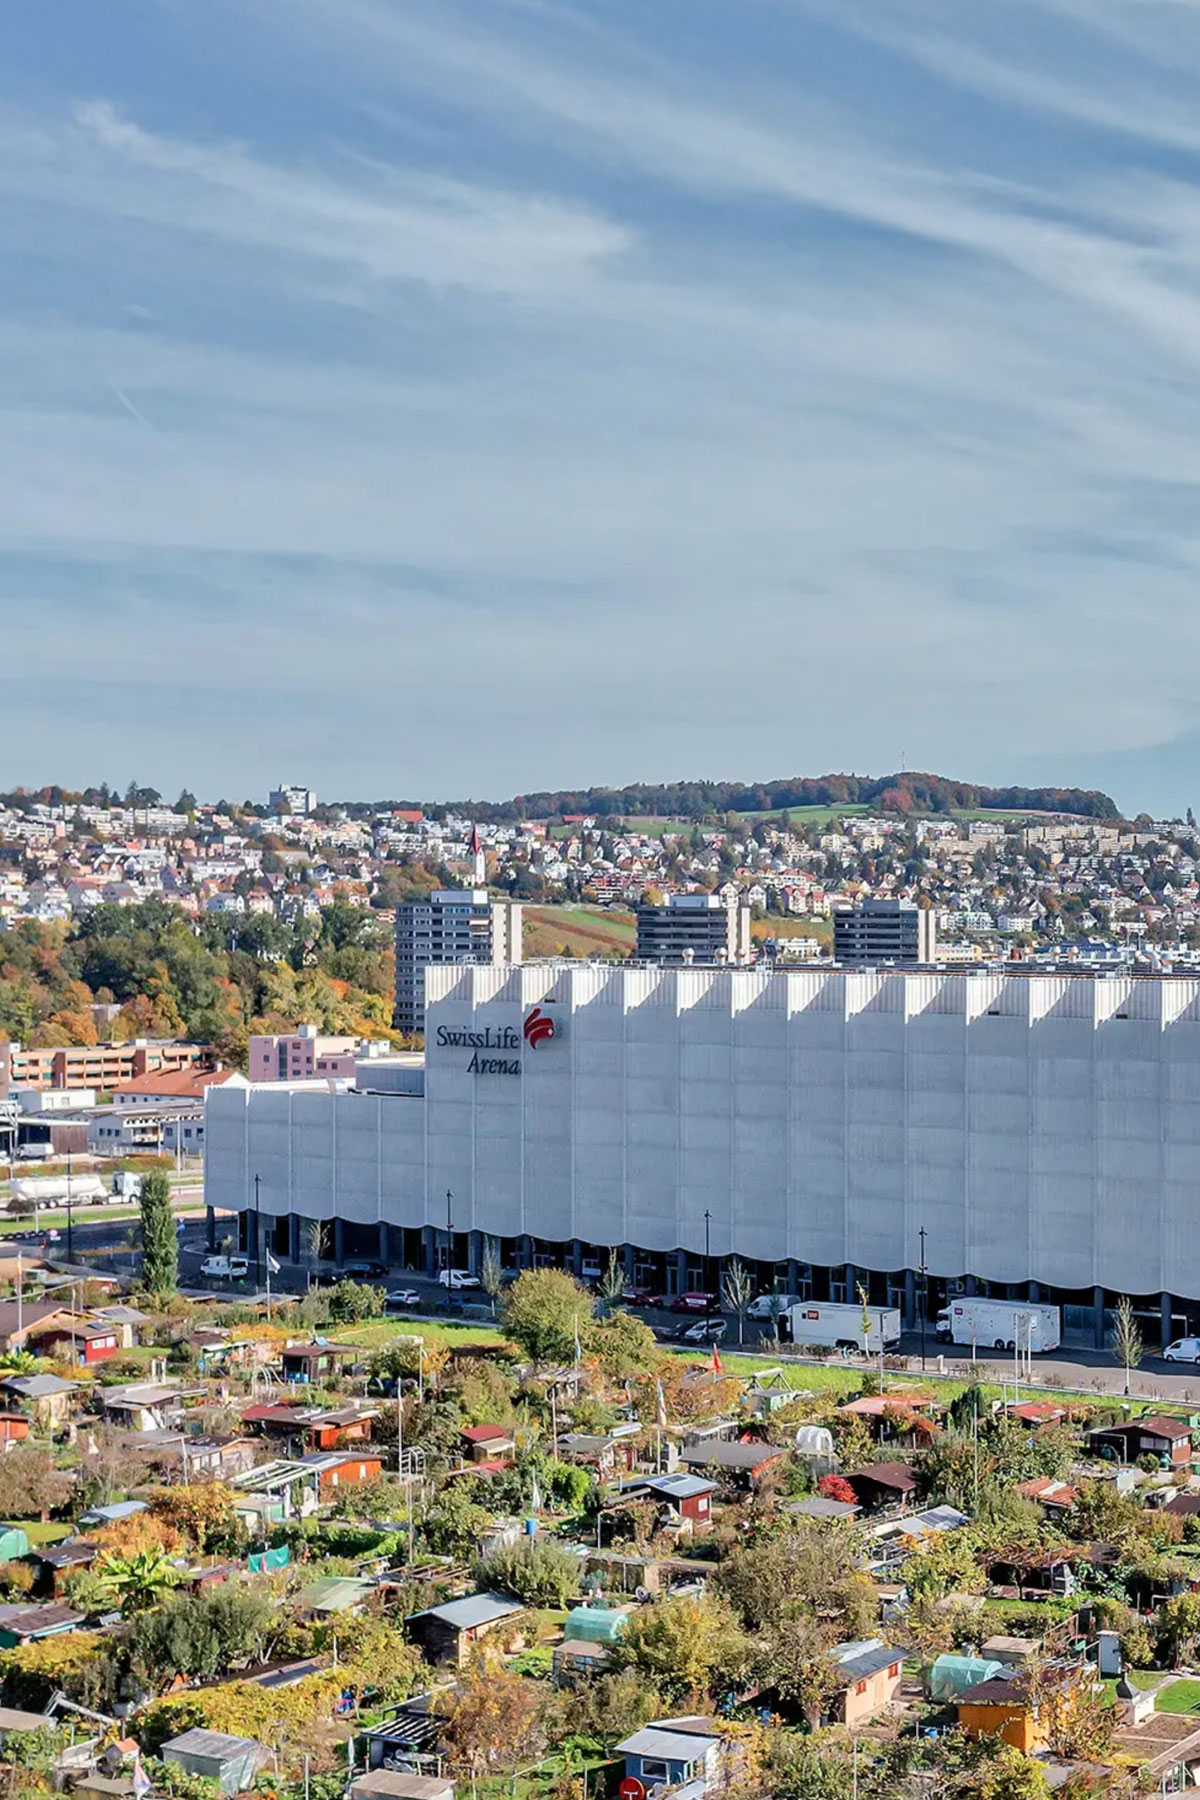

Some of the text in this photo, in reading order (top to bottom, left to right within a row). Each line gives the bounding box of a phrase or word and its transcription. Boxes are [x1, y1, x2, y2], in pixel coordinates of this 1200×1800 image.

[436, 1025, 519, 1049] SwissLife
[467, 1051, 519, 1075] Arena
[956, 1281, 965, 1293] D
